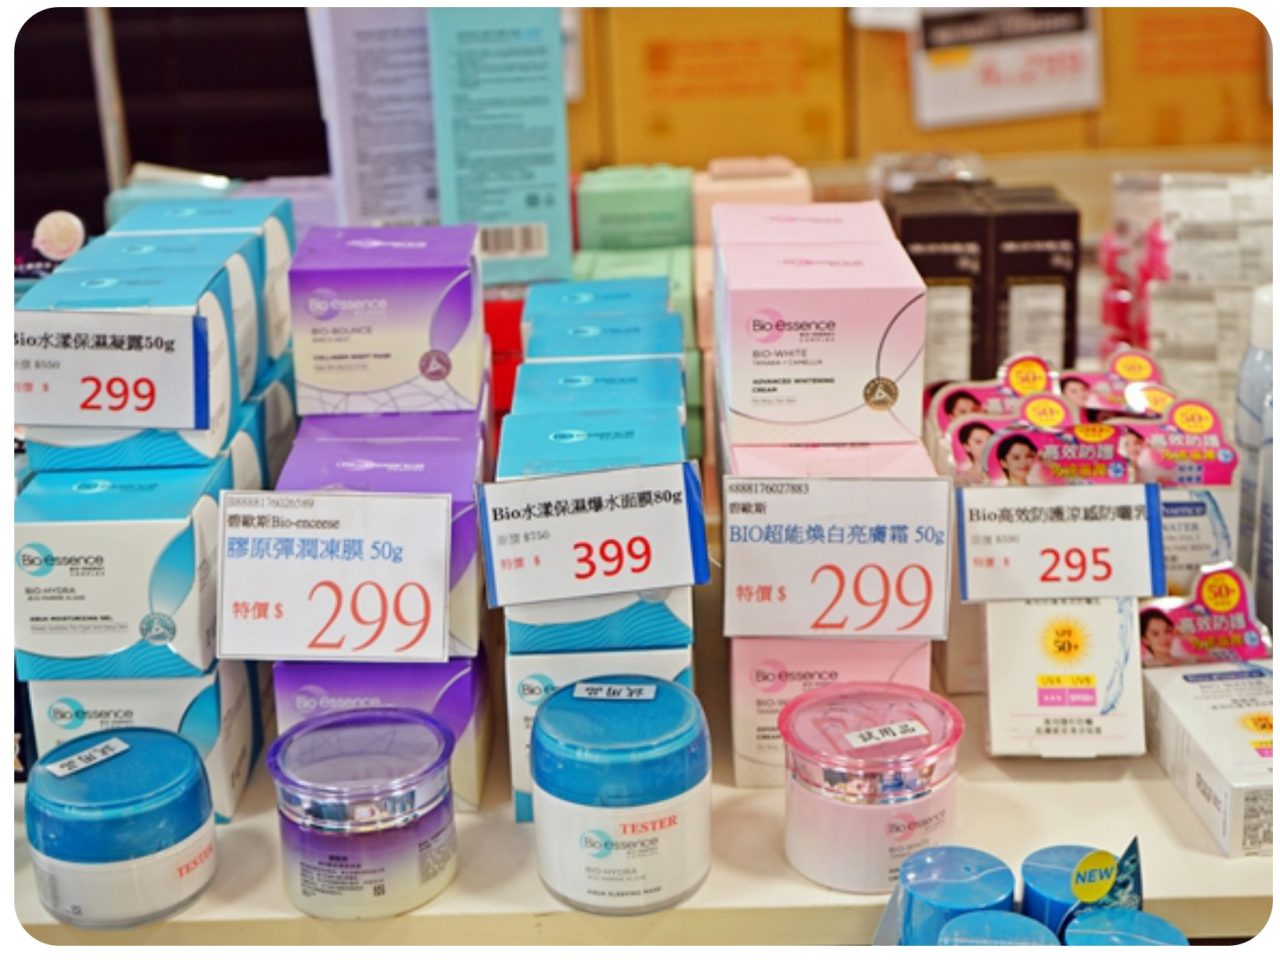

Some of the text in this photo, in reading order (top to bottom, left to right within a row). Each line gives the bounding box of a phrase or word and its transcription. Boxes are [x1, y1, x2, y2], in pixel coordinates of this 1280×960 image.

[752, 319, 836, 332] Bio essence
[753, 349, 808, 358] BIO-WHITE
[79, 376, 156, 412] 299
[915, 526, 945, 546] 50g
[22, 554, 104, 567] Bio essence
[370, 541, 403, 563] 50g
[573, 535, 652, 580] 399
[1040, 547, 1112, 582] 295
[736, 585, 787, 602] 特價 $
[810, 563, 932, 631] 299
[232, 601, 284, 620] 特價 $
[307, 580, 431, 653] 299
[755, 669, 838, 682] Bio essence
[320, 696, 381, 708] essence
[75, 708, 133, 719] essence
[620, 815, 678, 835] TESTER
[1075, 867, 1115, 885] NEW
